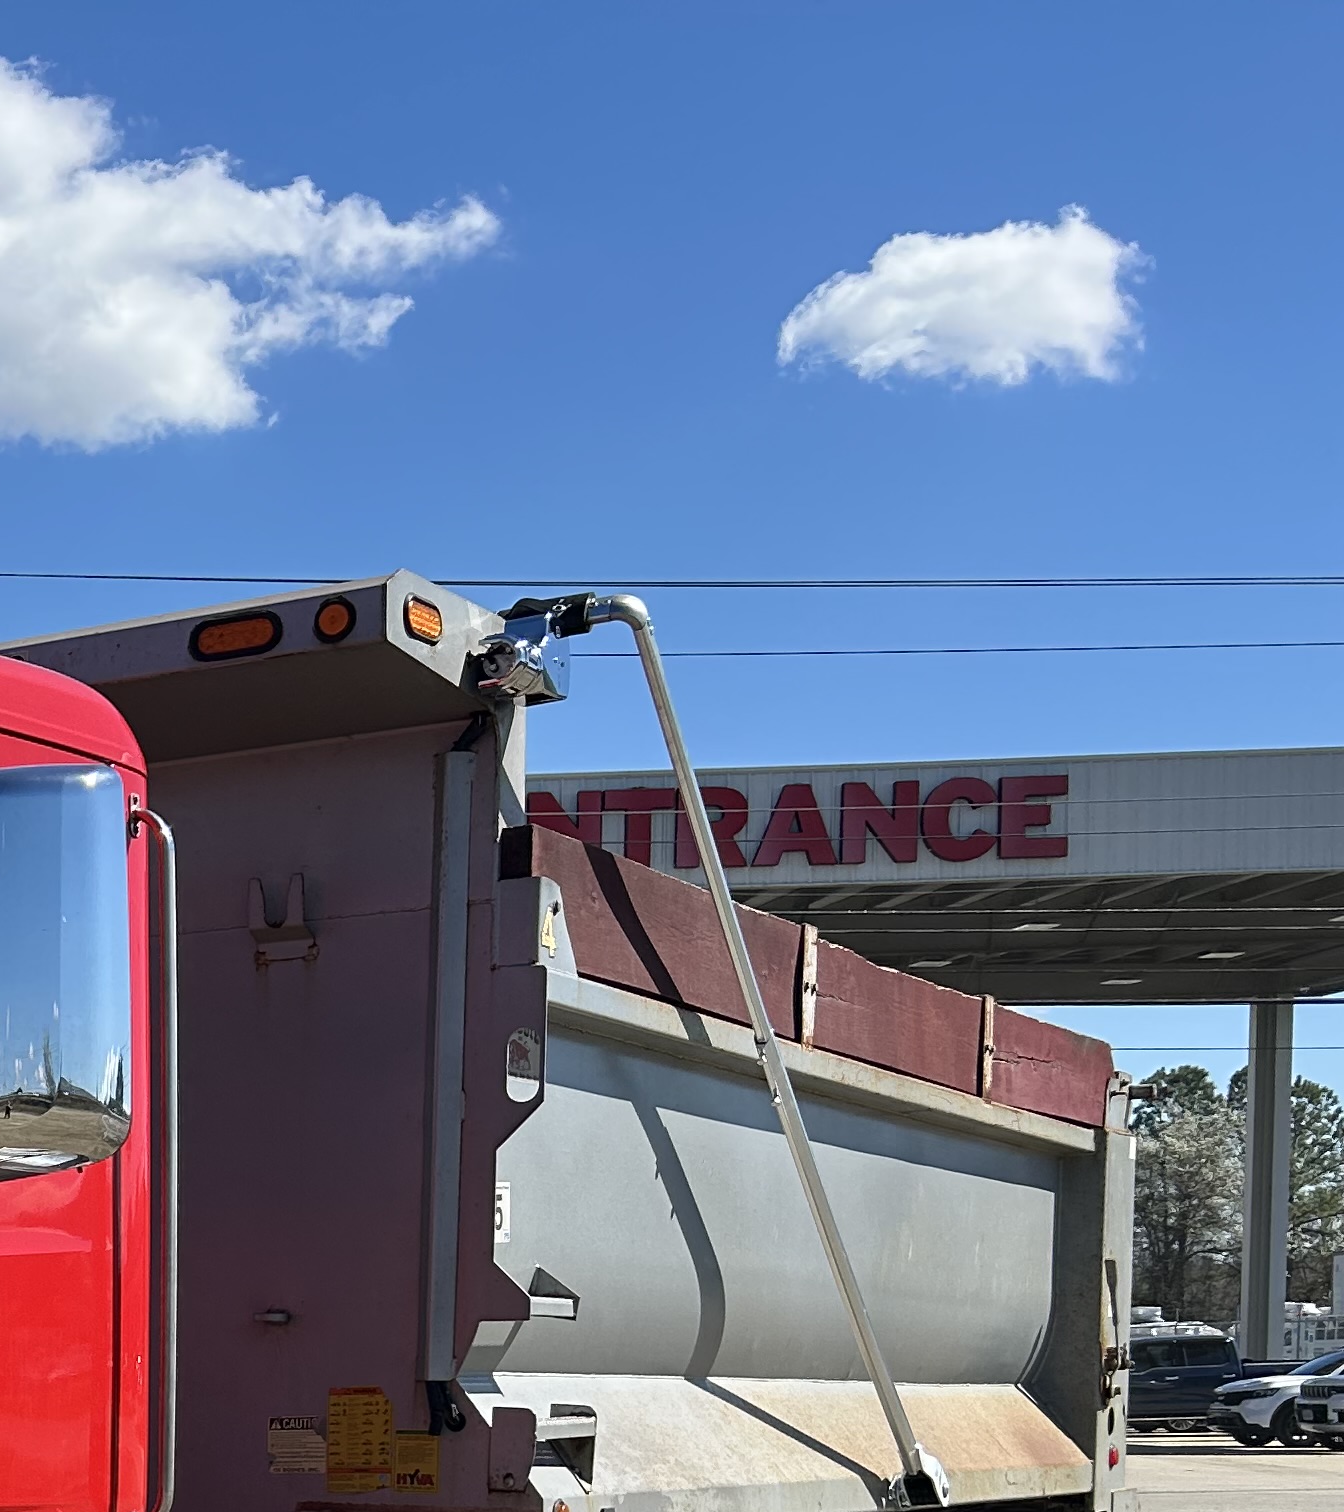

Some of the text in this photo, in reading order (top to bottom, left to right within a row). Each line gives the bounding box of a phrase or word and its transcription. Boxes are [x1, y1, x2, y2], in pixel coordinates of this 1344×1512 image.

[525, 774, 1070, 870] NTRANCE
[541, 906, 557, 957] 4
[282, 1417, 318, 1430] CAUTI
[396, 1468, 436, 1486] HYVA
